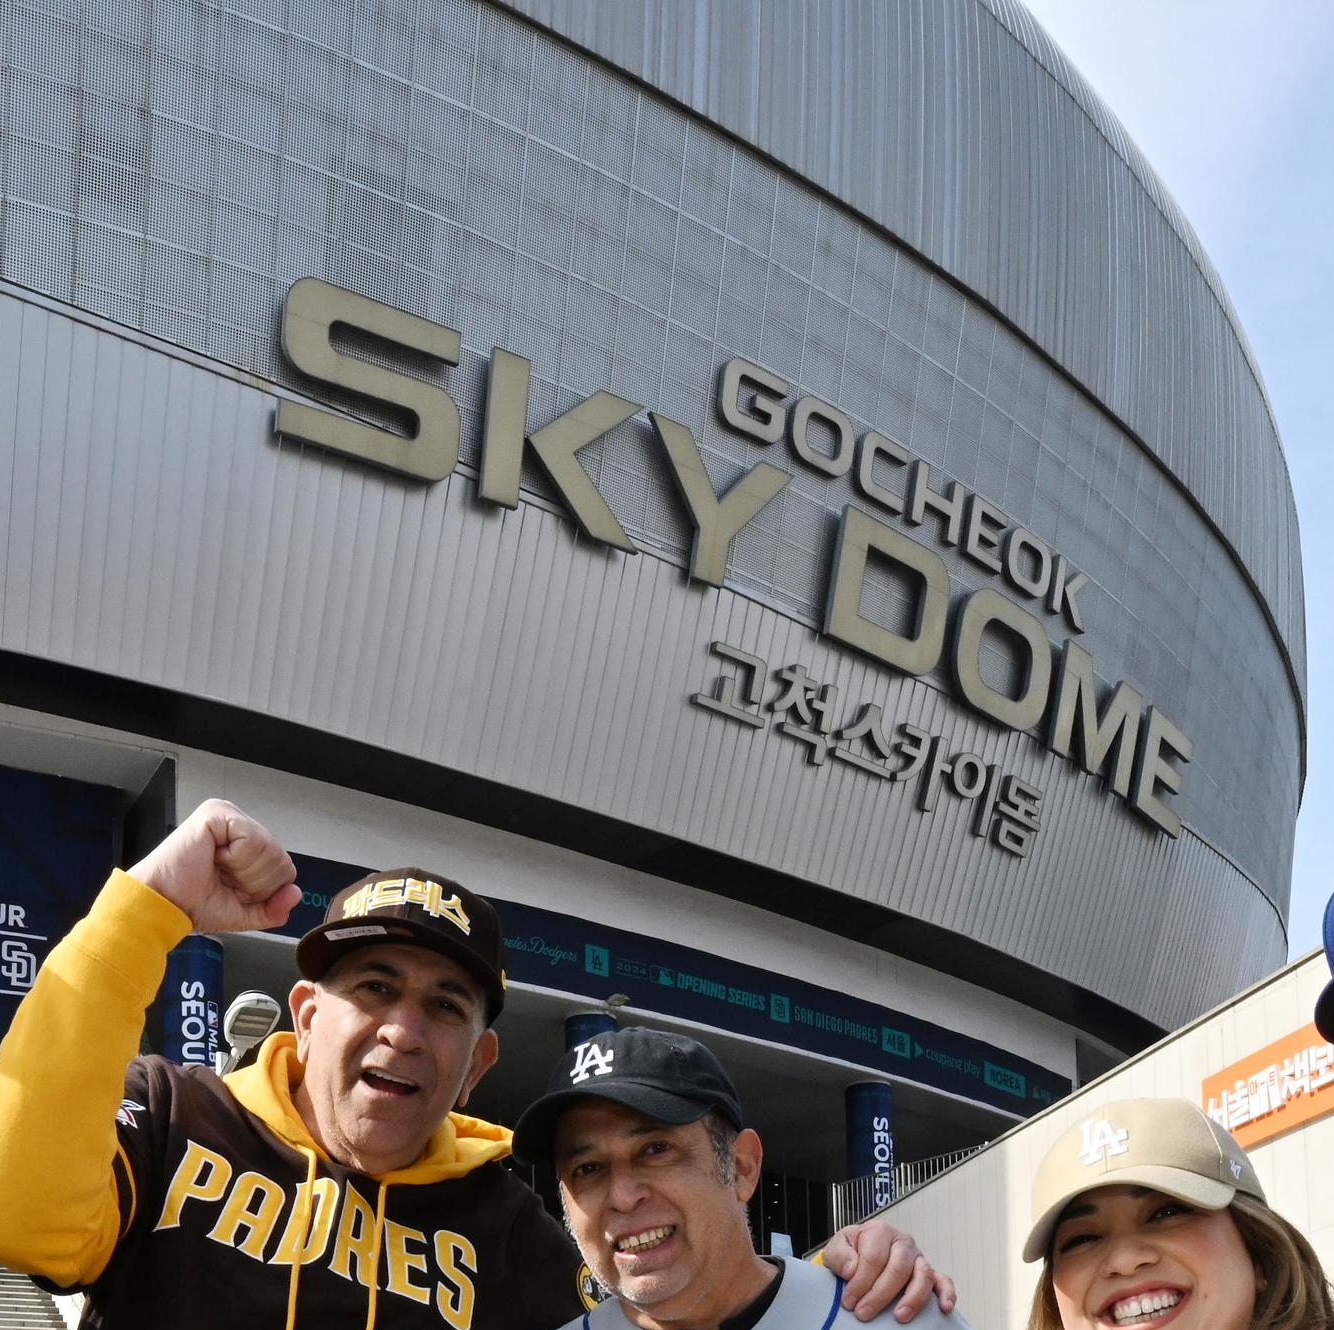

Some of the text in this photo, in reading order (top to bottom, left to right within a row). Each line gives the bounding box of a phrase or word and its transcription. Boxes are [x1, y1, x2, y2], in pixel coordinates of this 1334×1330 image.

[718, 357, 1090, 633] GOCHEOK
[274, 276, 1194, 838] SKY DOME
[690, 641, 1044, 859] 고척스카이돔
[342, 877, 472, 937] 파드레스
[570, 1042, 614, 1085] LA
[676, 972, 726, 1000] OPENING
[727, 987, 766, 1011] SERIES
[794, 1005, 814, 1025] SAN
[815, 1012, 843, 1033] DIEGO
[990, 1068, 1022, 1092] KOREA
[872, 1116, 890, 1190] SEOUL
[1078, 1118, 1129, 1168] LA
